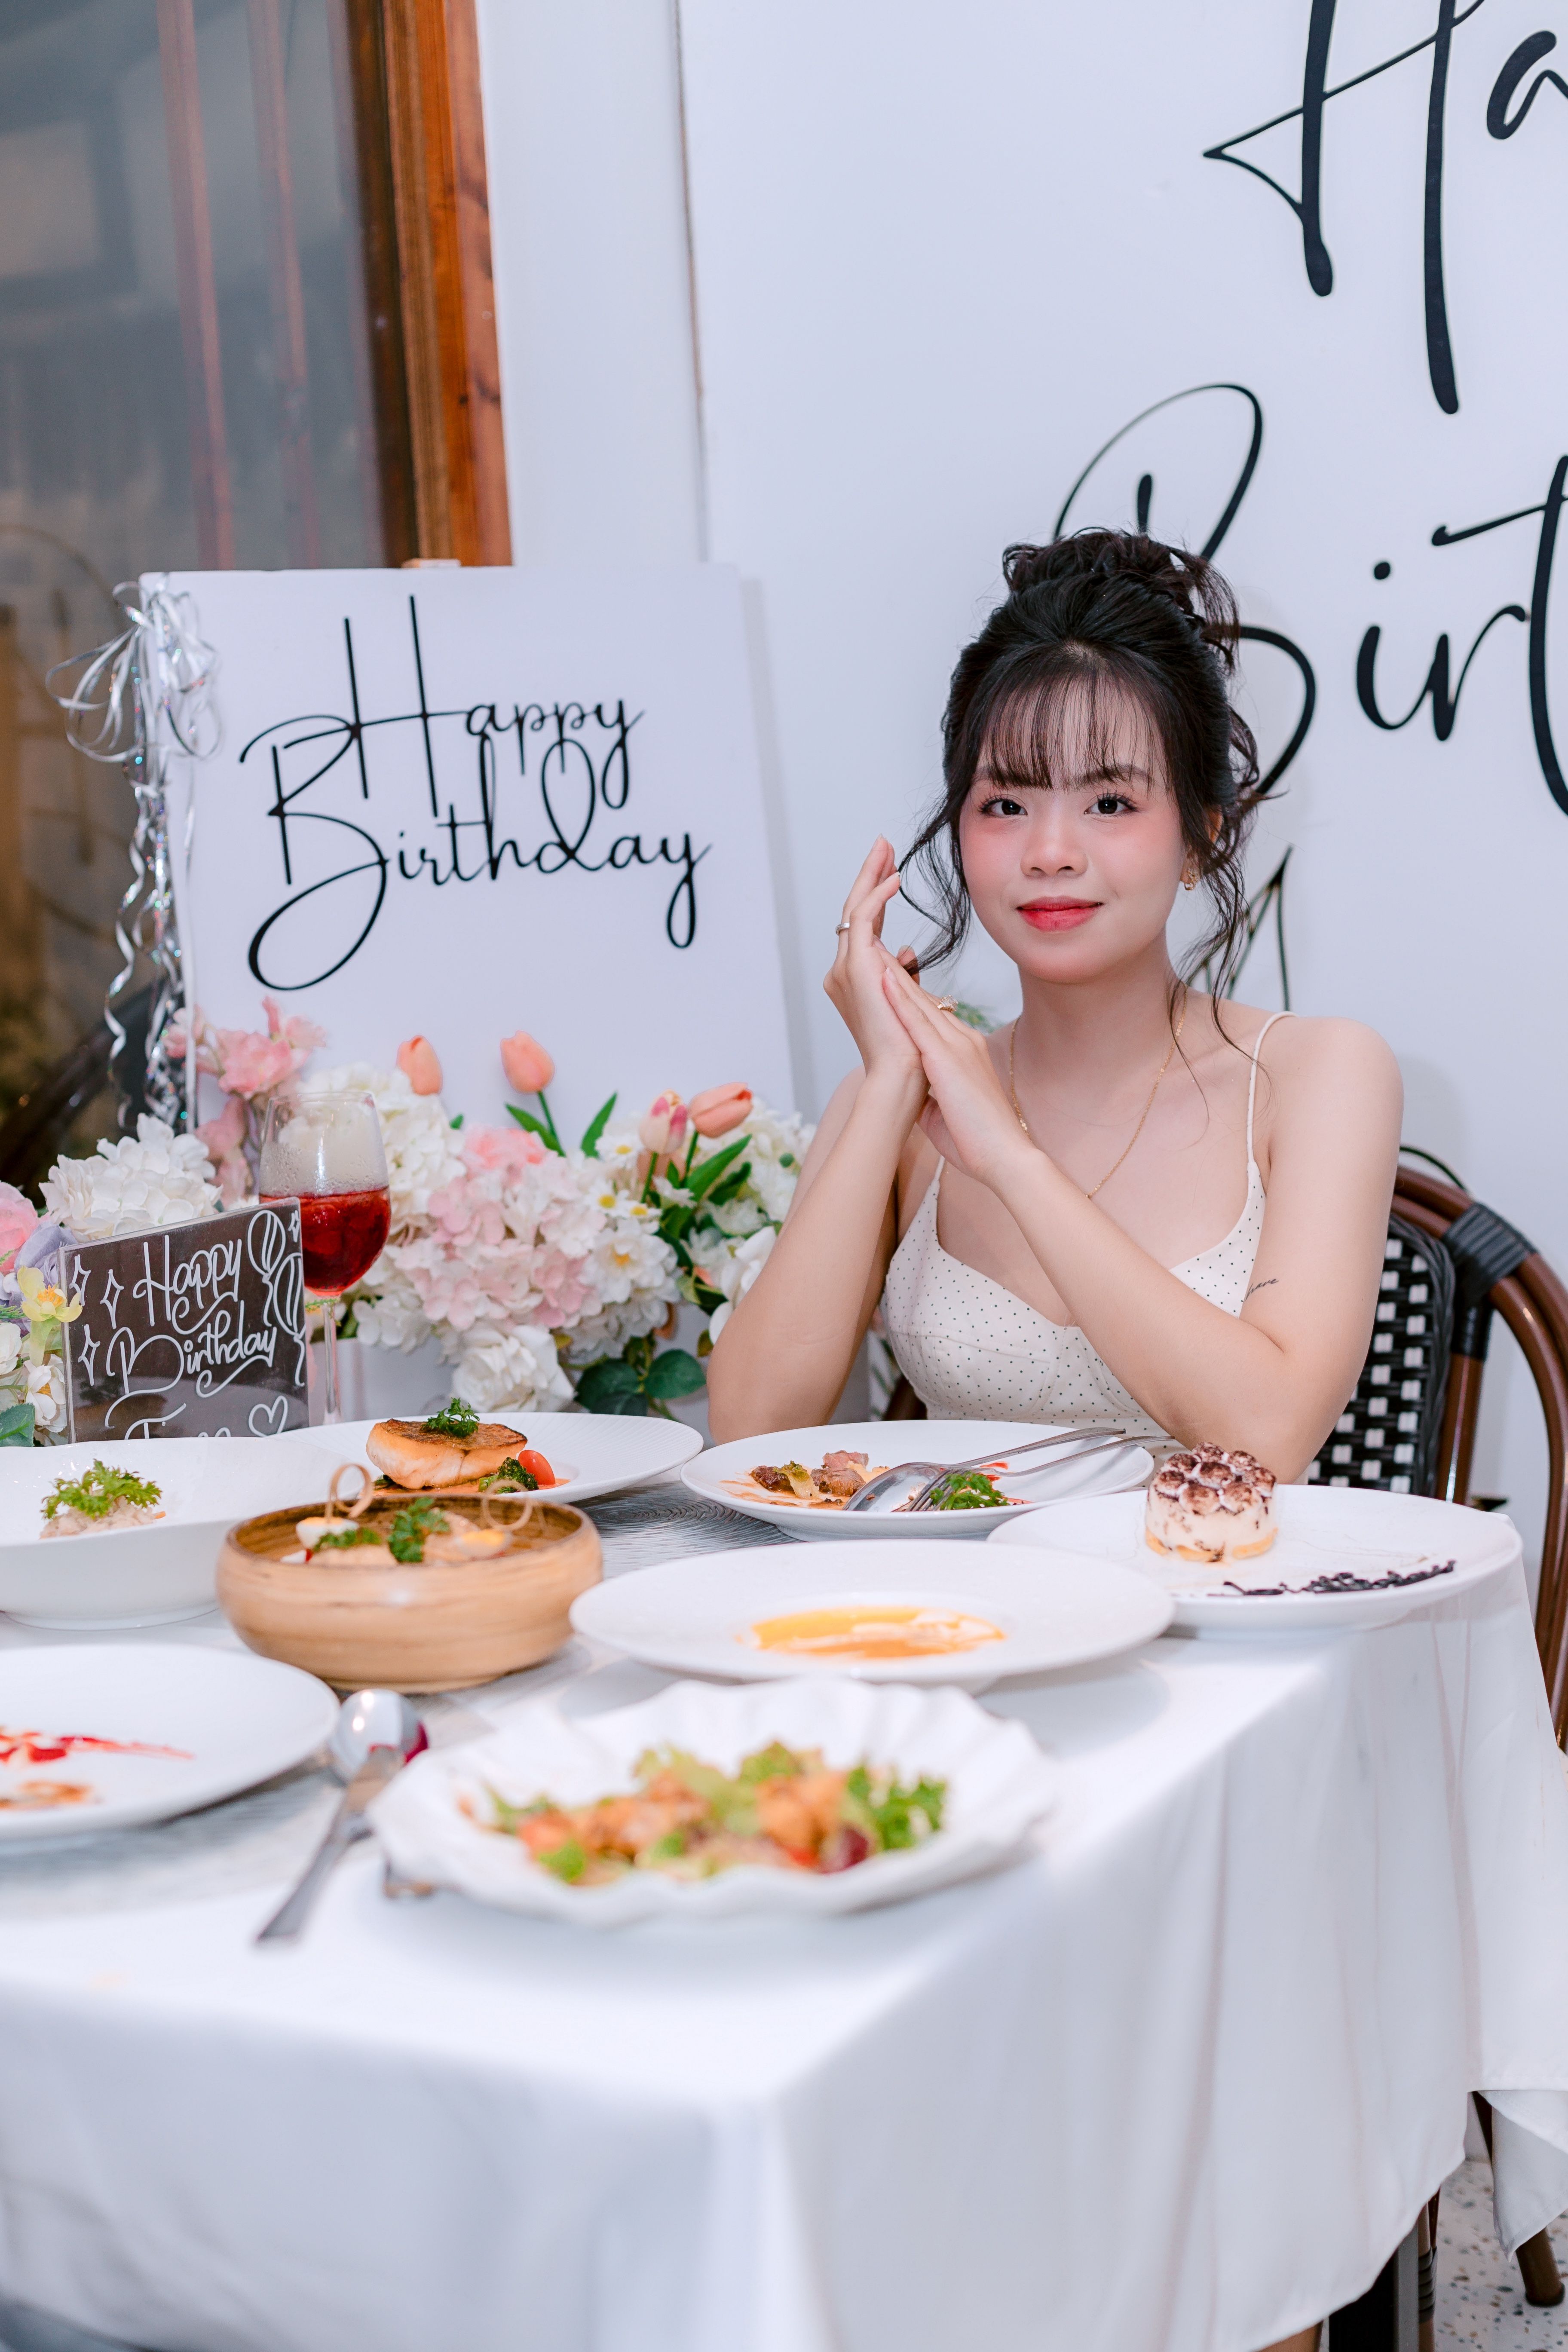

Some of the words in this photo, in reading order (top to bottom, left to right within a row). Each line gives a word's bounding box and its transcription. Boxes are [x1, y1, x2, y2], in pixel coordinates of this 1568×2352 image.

[284, 595, 645, 818] Happy
[239, 715, 713, 991] Birthday
[105, 1300, 277, 1429] Birthday
[133, 1234, 242, 1335] Happy
